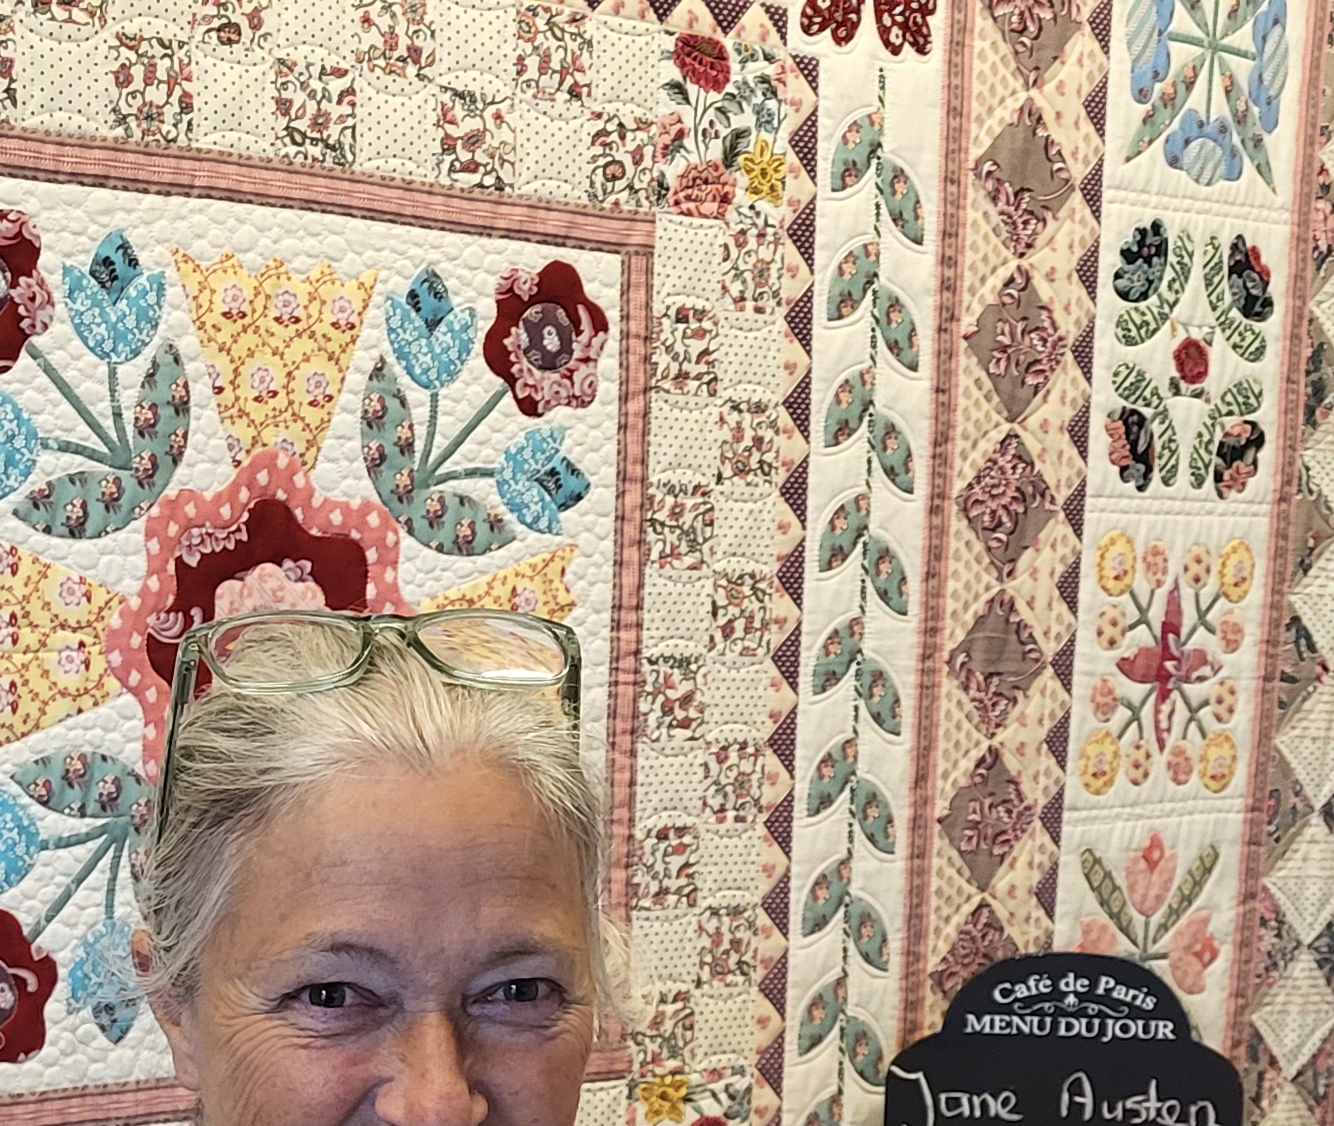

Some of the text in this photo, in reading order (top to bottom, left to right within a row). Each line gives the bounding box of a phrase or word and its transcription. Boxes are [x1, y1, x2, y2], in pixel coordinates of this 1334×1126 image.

[993, 971, 1158, 1011] Café de Paris
[964, 1013, 1178, 1043] MENU DU JOUR
